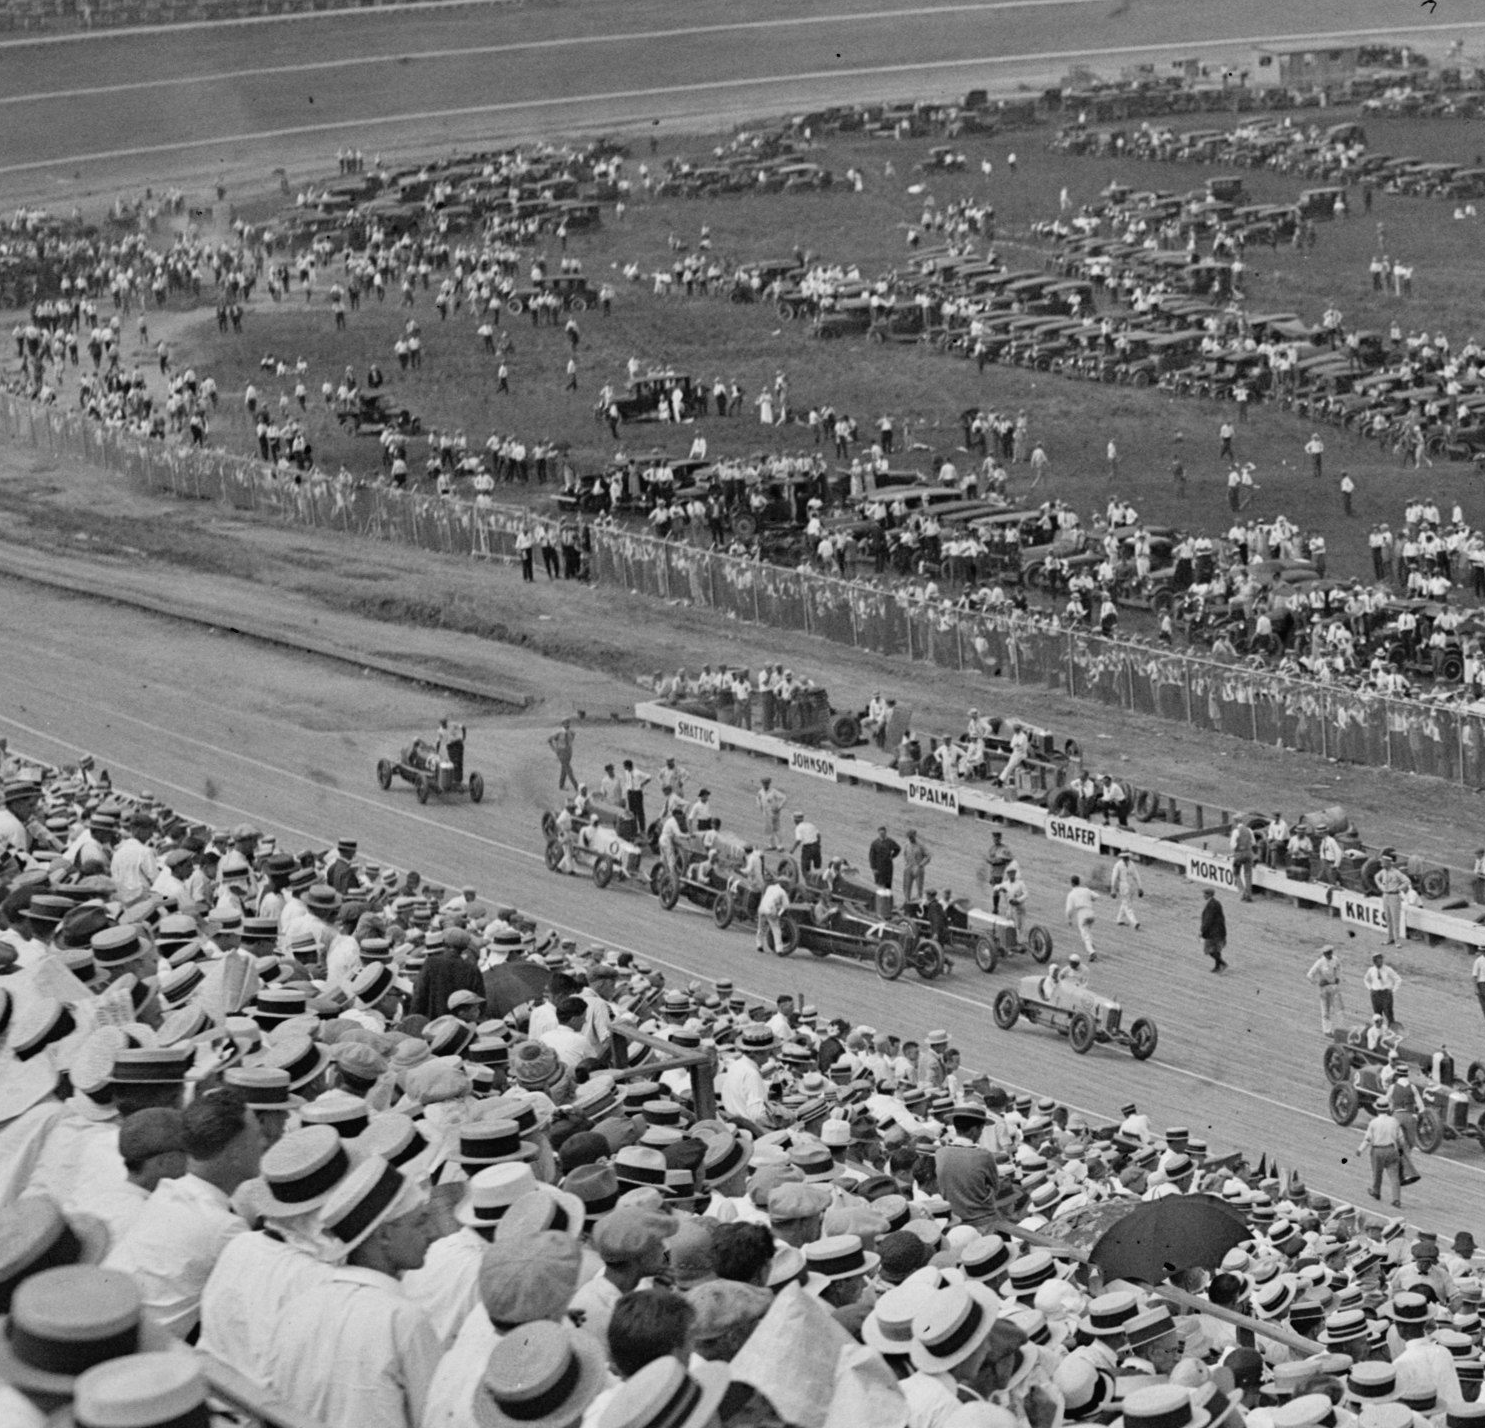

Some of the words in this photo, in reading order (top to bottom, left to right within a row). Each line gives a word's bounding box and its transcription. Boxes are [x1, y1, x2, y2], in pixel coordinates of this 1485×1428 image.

[678, 721, 715, 744] SHATTUC
[791, 752, 834, 776] JOHNSON
[1050, 820, 1096, 846] SHAFER
[1190, 858, 1238, 886] MORTO
